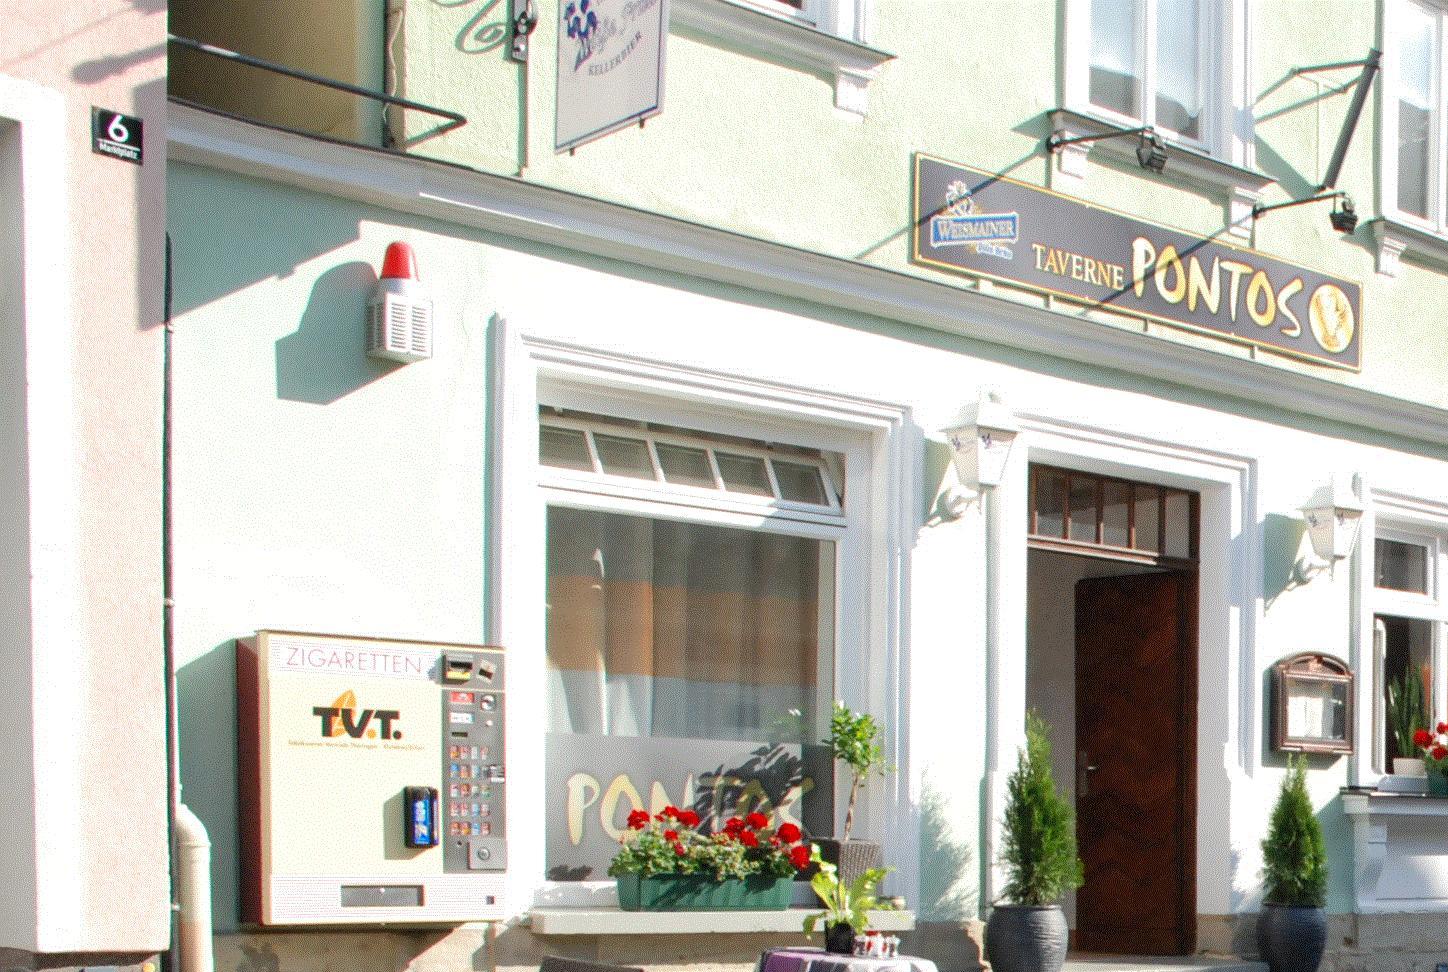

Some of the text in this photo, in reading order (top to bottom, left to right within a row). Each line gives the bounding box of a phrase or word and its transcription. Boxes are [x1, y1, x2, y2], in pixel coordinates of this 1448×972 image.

[107, 114, 129, 144] 6
[1032, 236, 1304, 338] TAVERNE PONTOS
[286, 646, 422, 674] ZIGARETTEN
